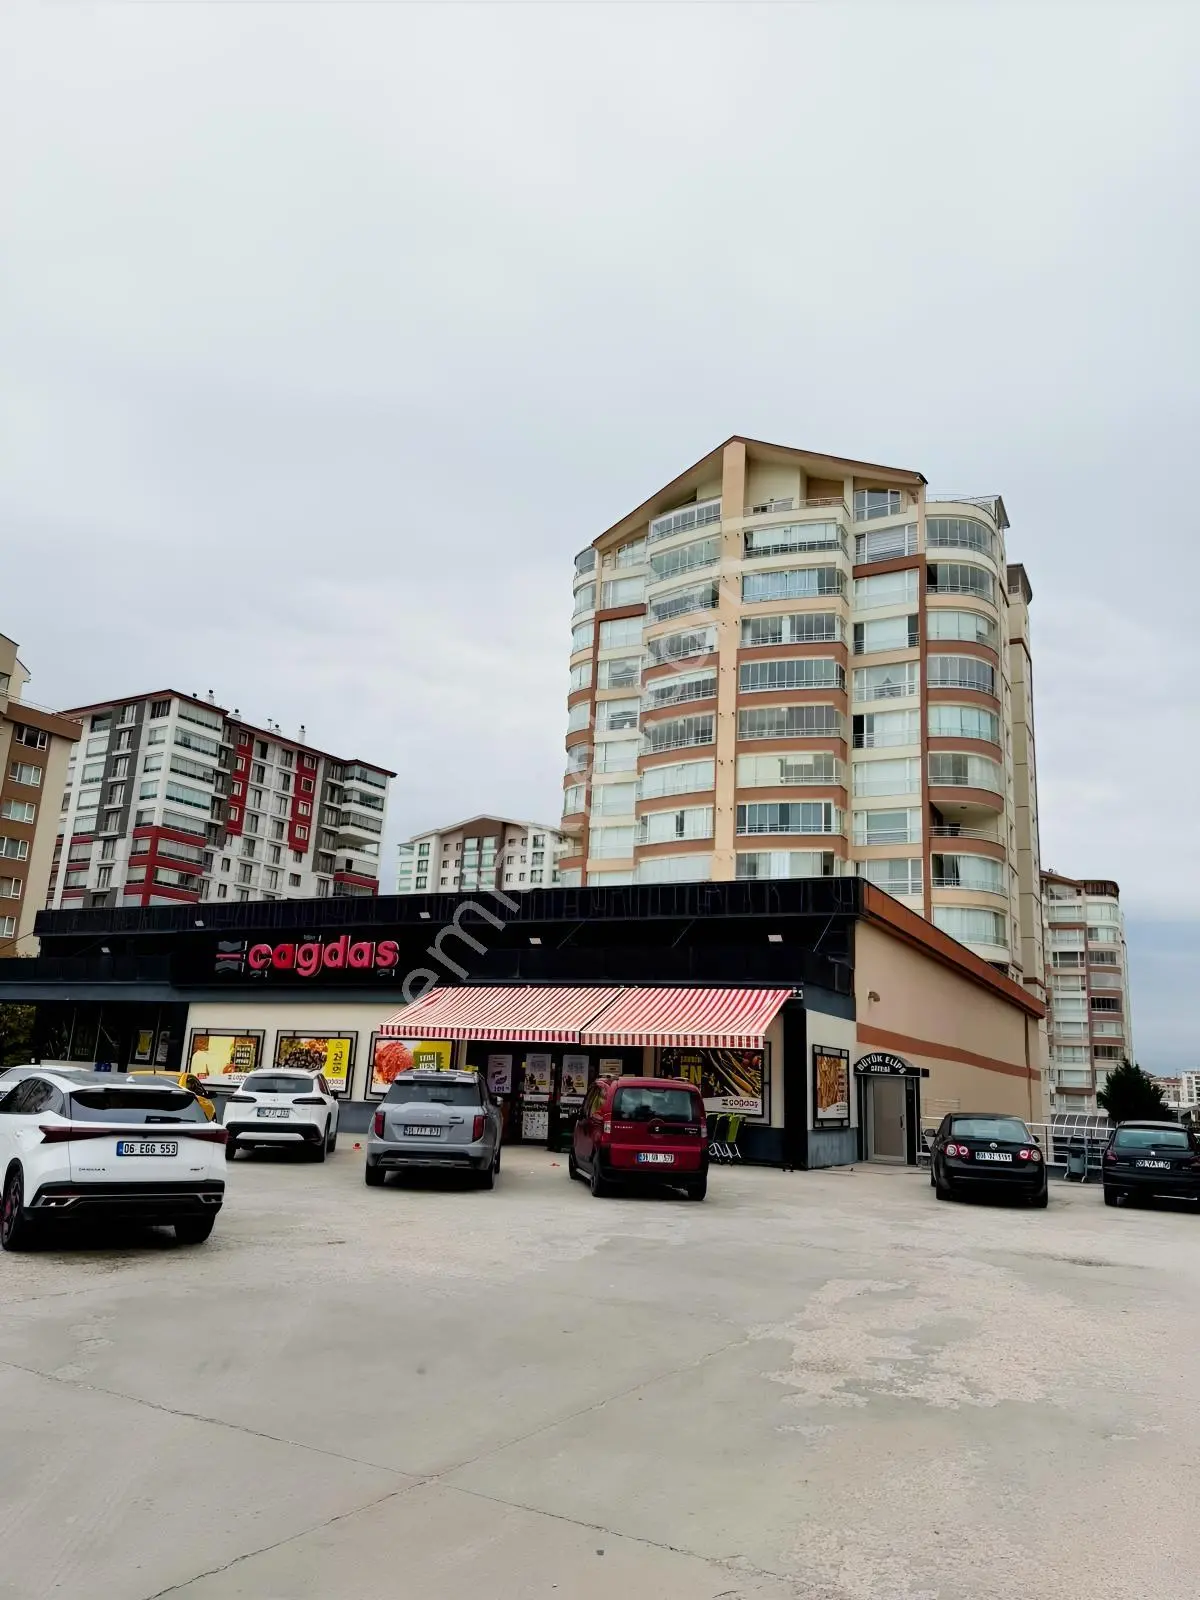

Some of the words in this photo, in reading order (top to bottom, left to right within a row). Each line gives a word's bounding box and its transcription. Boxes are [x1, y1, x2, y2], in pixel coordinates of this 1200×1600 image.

[124, 1143, 135, 1154] 06
[140, 1143, 156, 1154] EGG
[160, 1143, 176, 1154] 553
